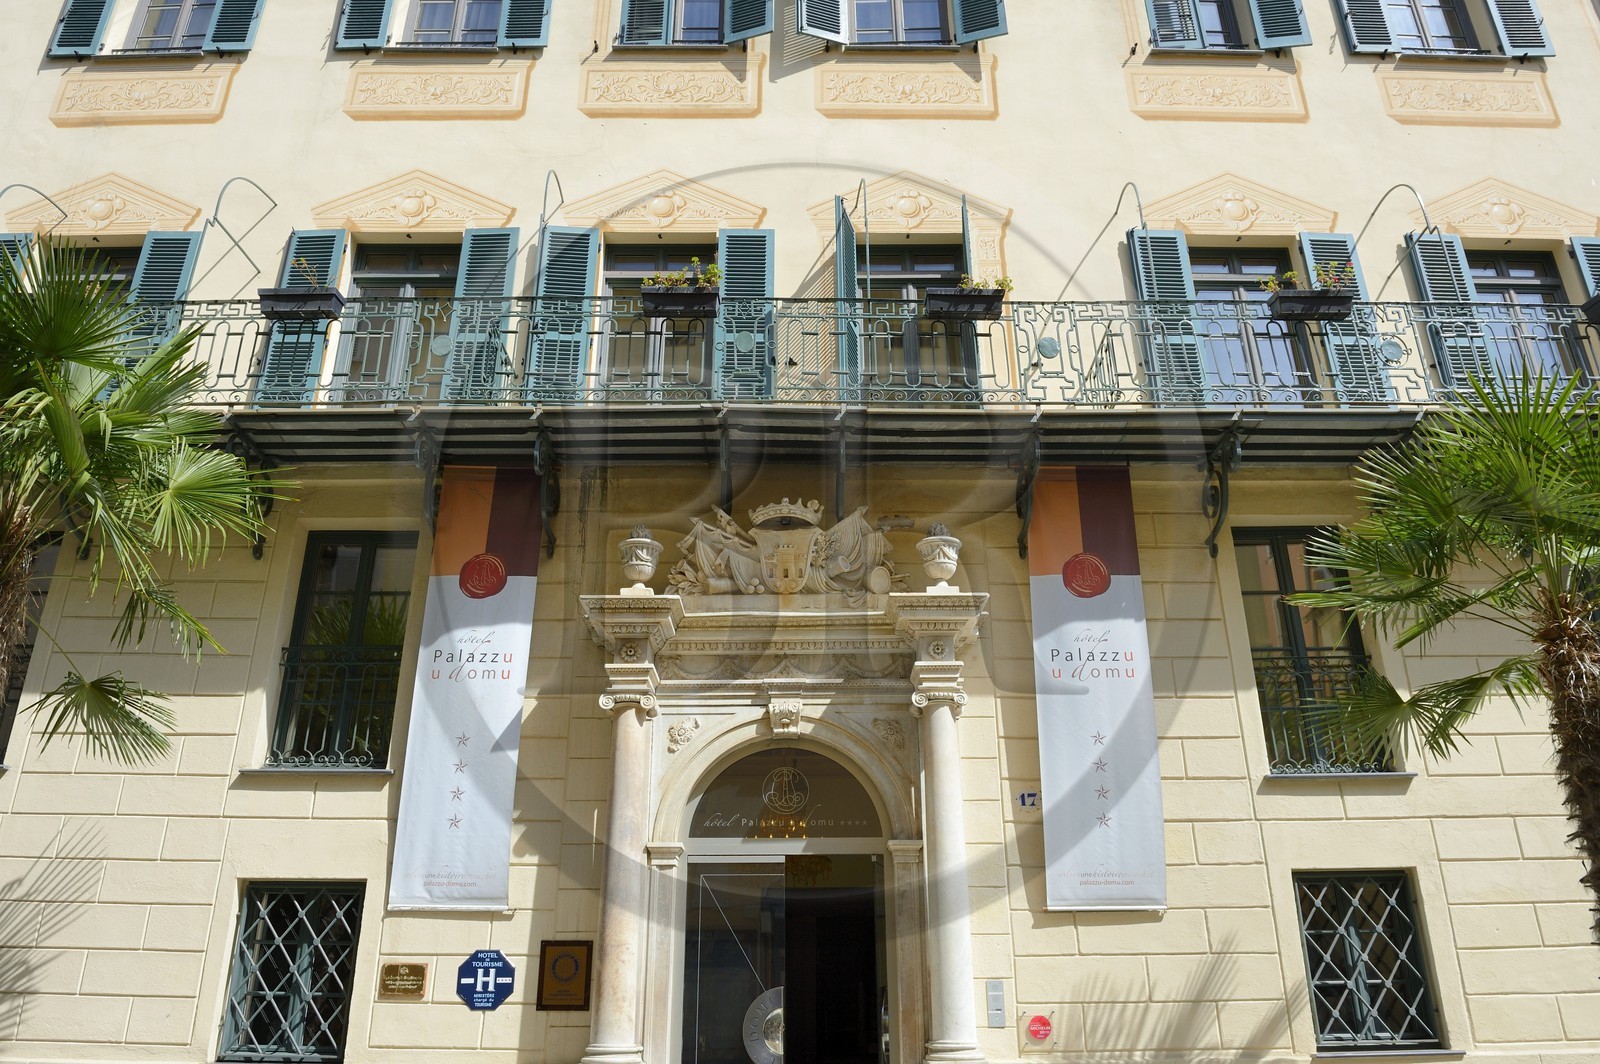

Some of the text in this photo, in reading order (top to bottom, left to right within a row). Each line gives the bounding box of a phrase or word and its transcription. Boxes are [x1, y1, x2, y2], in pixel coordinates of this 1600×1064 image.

[433, 648, 513, 663] Palazzu
[1050, 647, 1134, 662] Palazzu
[431, 669, 441, 680] u
[1051, 668, 1062, 679] u
[1018, 793, 1037, 807] 17
[703, 812, 740, 827] hôtel
[475, 968, 497, 992] H
